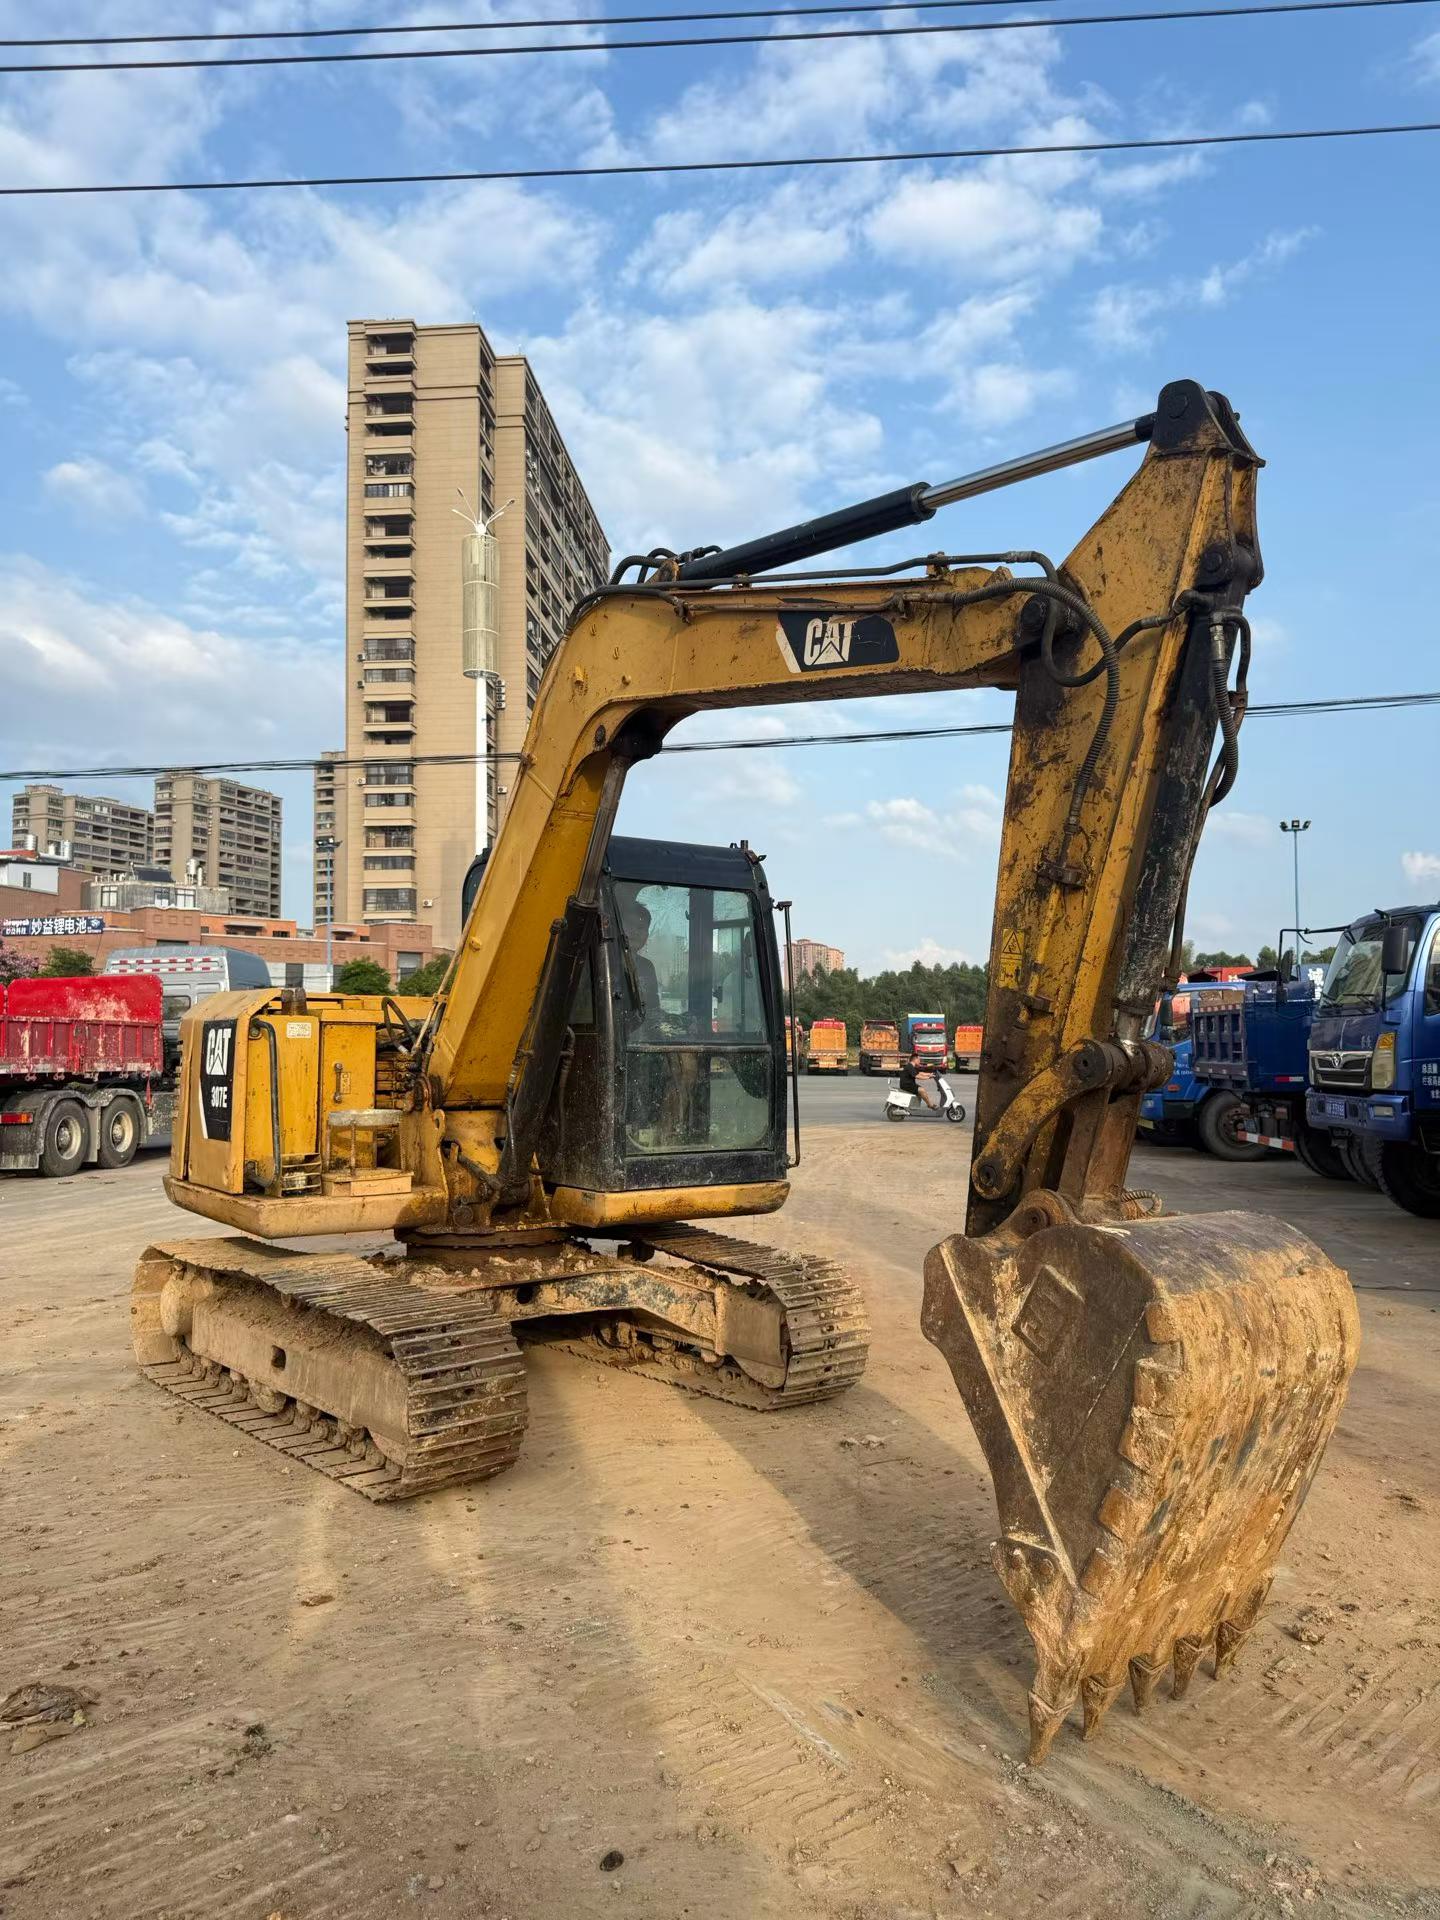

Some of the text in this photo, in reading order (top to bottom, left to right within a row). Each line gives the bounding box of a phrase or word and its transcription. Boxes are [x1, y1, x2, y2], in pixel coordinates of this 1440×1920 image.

[804, 618, 857, 666] CAT
[31, 917, 87, 936] 妙益锂电池
[206, 1028, 232, 1076] CAT
[211, 1086, 228, 1108] 307E
